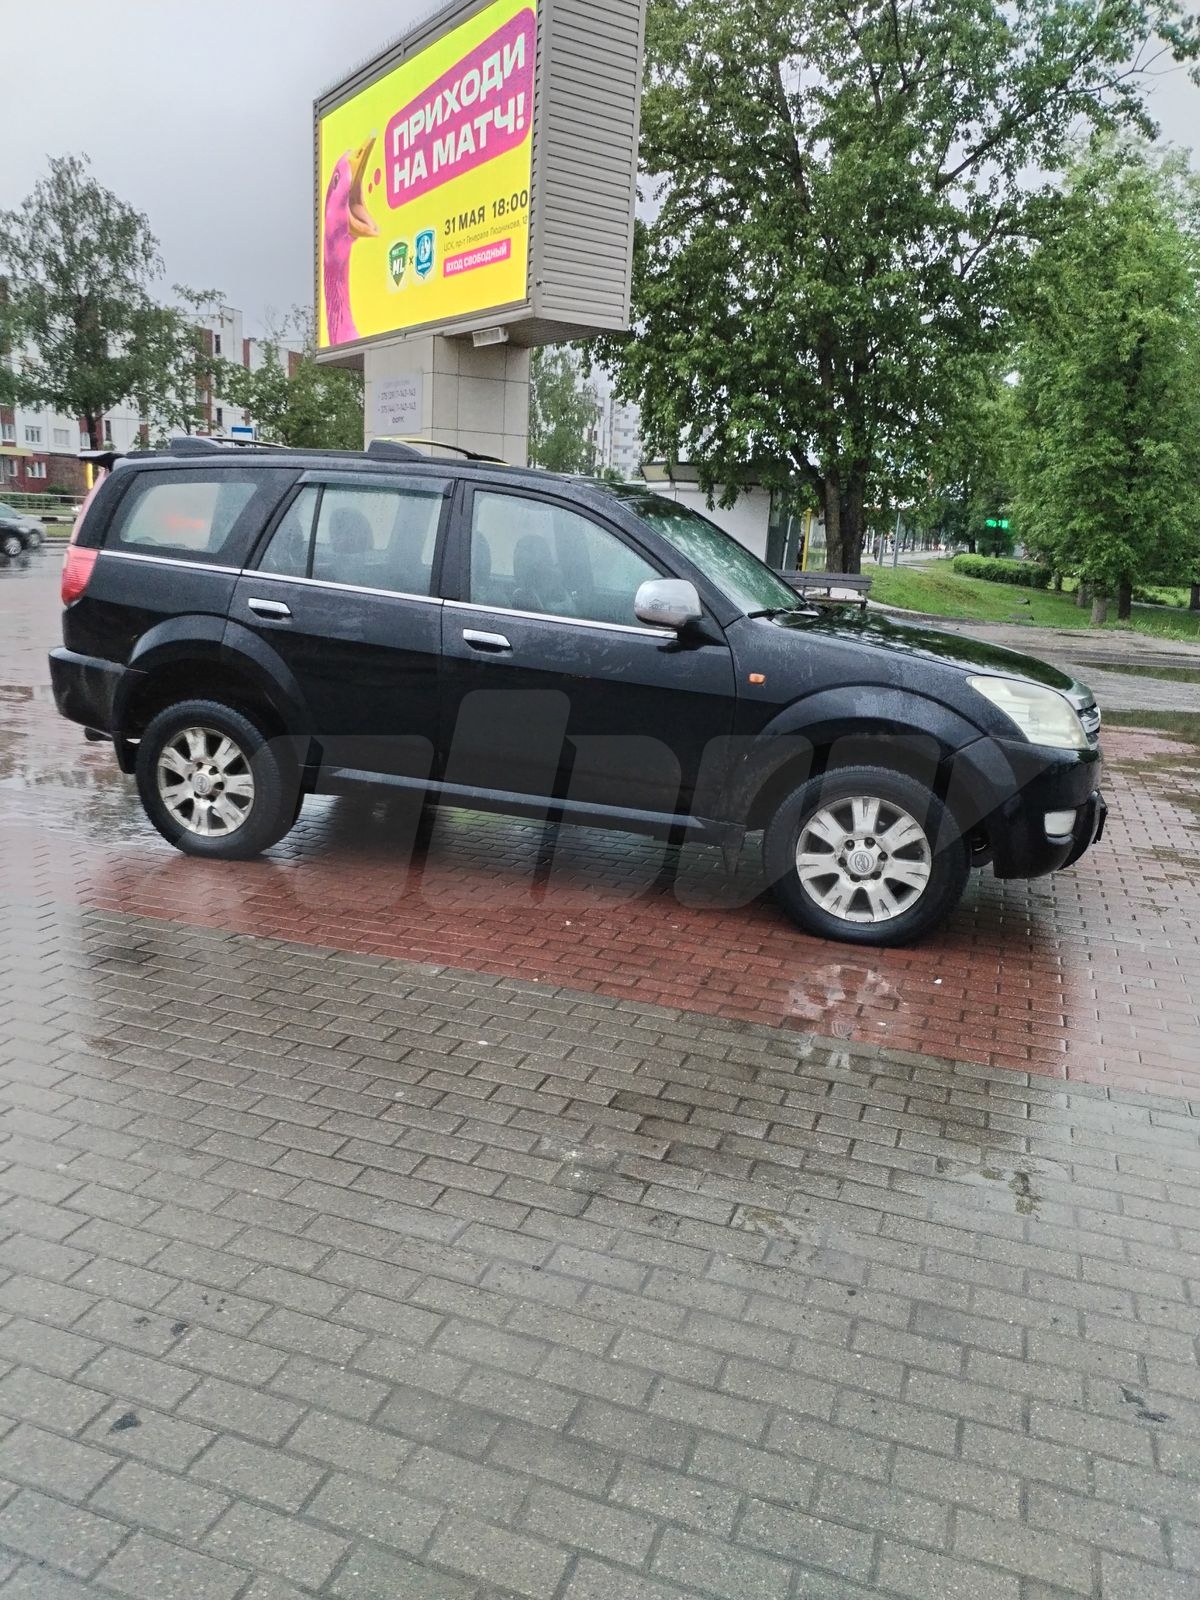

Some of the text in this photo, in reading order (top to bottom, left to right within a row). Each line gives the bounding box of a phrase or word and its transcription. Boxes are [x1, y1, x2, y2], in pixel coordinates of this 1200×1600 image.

[393, 32, 526, 158] ПРИХОДИ
[393, 91, 526, 194] НА МАТЧ!
[444, 189, 528, 236] 31 МАЯ 18:00
[445, 257, 463, 274] ВХОД
[463, 241, 508, 269] СВОБОДНЫЙ
